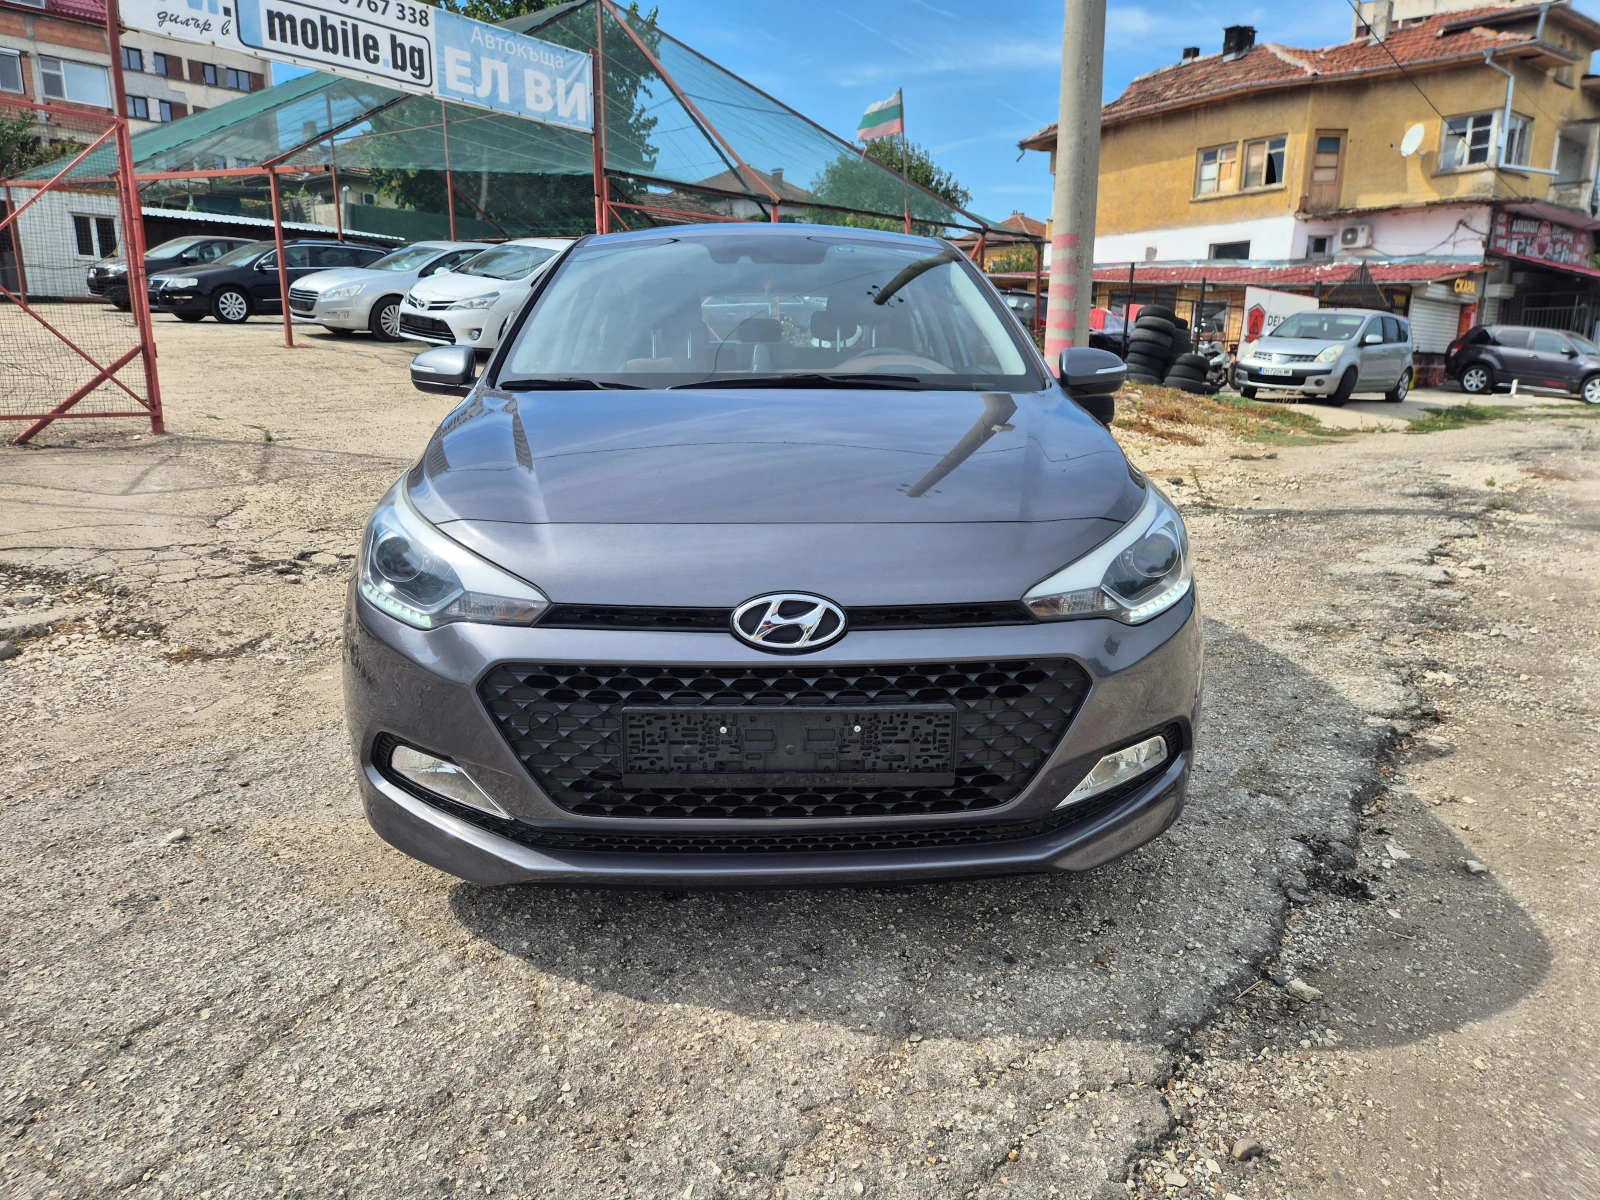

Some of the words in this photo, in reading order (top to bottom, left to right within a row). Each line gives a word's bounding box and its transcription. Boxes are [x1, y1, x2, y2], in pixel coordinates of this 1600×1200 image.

[157, 11, 213, 35] дилър
[396, 3, 429, 27] 338
[266, 9, 425, 80] mobile.bg
[470, 26, 564, 70] Автокъща
[444, 46, 510, 104] ЕЛ
[524, 68, 586, 122] ВИ
